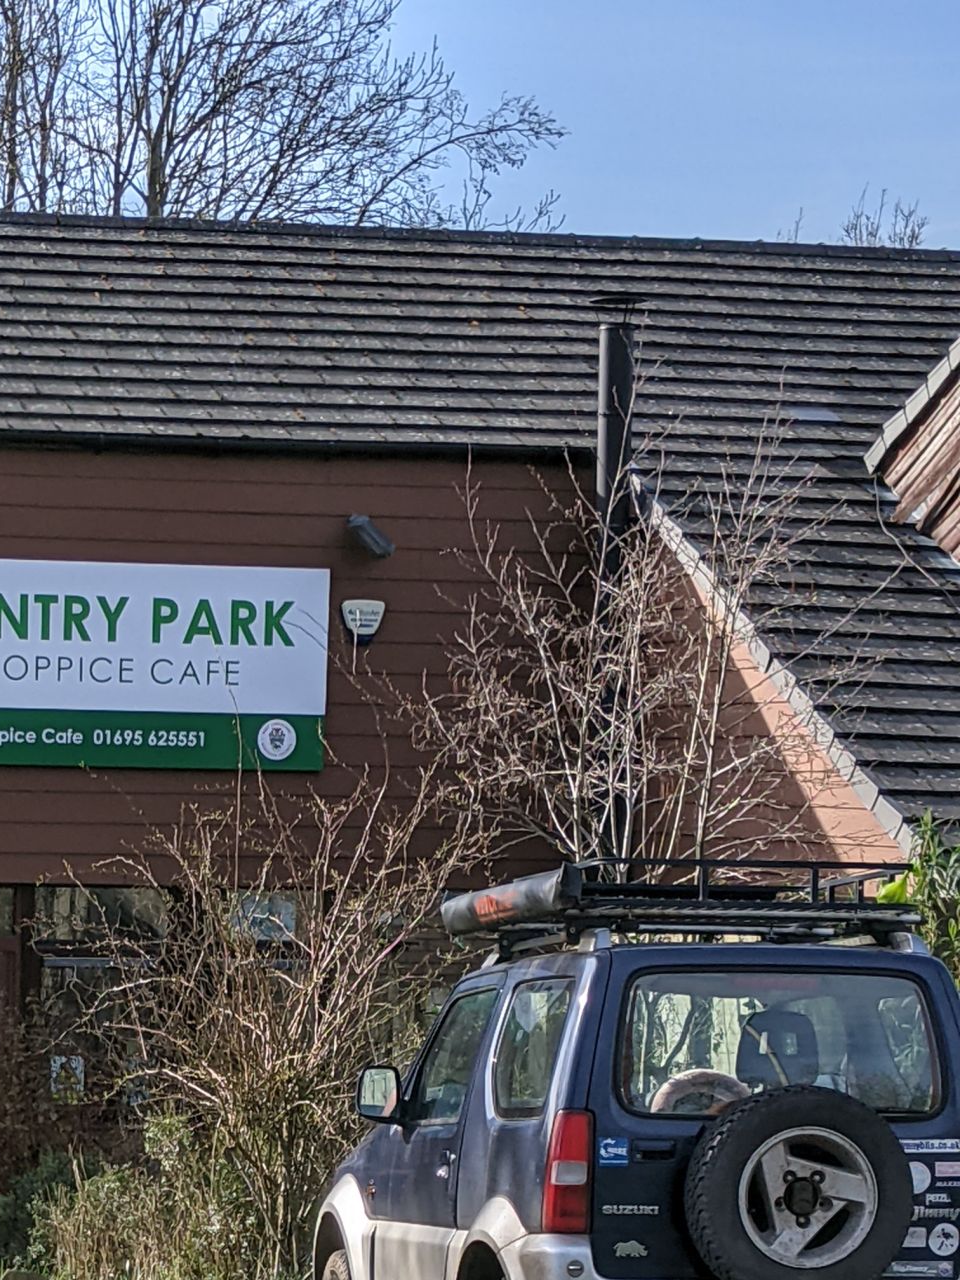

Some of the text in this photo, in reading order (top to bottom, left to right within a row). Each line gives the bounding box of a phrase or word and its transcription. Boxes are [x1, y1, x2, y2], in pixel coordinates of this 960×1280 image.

[152, 597, 295, 647] PARK
[151, 659, 240, 686] CAFE
[42, 729, 83, 745] Cafe
[94, 730, 143, 746] 01695
[149, 731, 205, 747] 625551
[602, 1205, 659, 1215] SUZUKI
